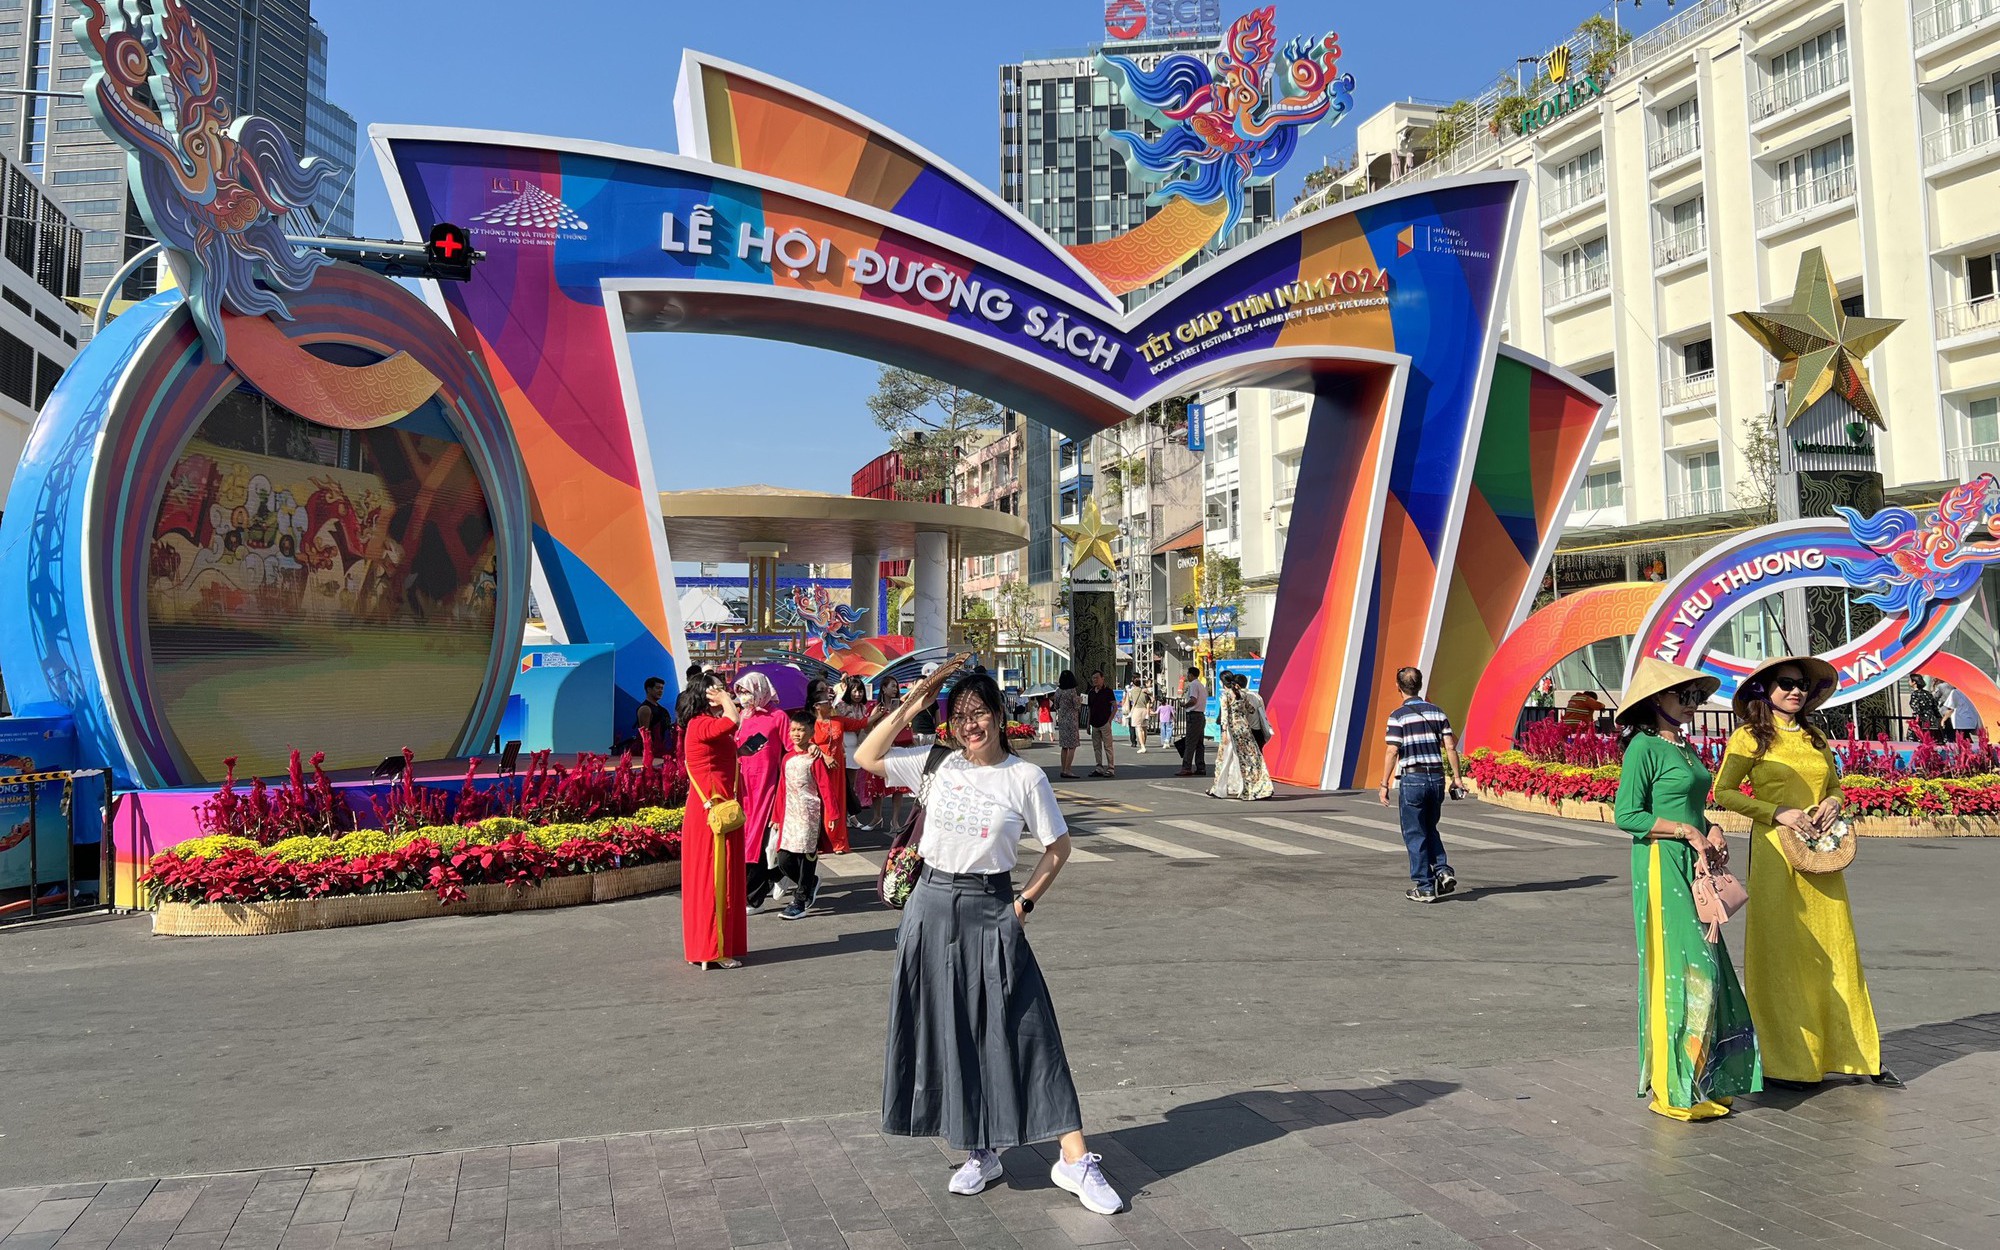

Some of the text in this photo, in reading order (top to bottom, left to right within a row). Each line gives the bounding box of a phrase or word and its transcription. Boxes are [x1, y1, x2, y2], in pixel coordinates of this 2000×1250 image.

[1152, 0, 1220, 25] SCB
[1520, 76, 1600, 134] ROLEX
[480, 228, 505, 236] THÔNG
[521, 230, 531, 238] VÀ
[533, 230, 560, 239] TRUYỀN
[661, 204, 1121, 372] LỄ HỘI ĐƯỜNG SÁCH
[1135, 332, 1173, 362] TẾT
[1176, 311, 1223, 343] GIÁP
[1275, 278, 1327, 308] NĂM
[1327, 267, 1389, 295] 2024
[1150, 357, 1175, 375] BOOK
[1174, 344, 1200, 363] STREET
[1201, 330, 1233, 350] FESTIVAL
[1233, 323, 1253, 337] 2024
[1260, 313, 1285, 328] LUNAR
[1285, 309, 1302, 321] NEW
[1305, 305, 1325, 316] YEAR
[1325, 302, 1337, 311] OF
[1338, 300, 1354, 310] THE
[1354, 297, 1389, 307] DRAGON
[1793, 439, 1875, 456] Vietcombank
[1177, 556, 1198, 569] GINKGO
[1565, 568, 1617, 582] REX ARCADE
[1673, 589, 1713, 629] YÊU
[1712, 548, 1825, 595] THƯƠNG
